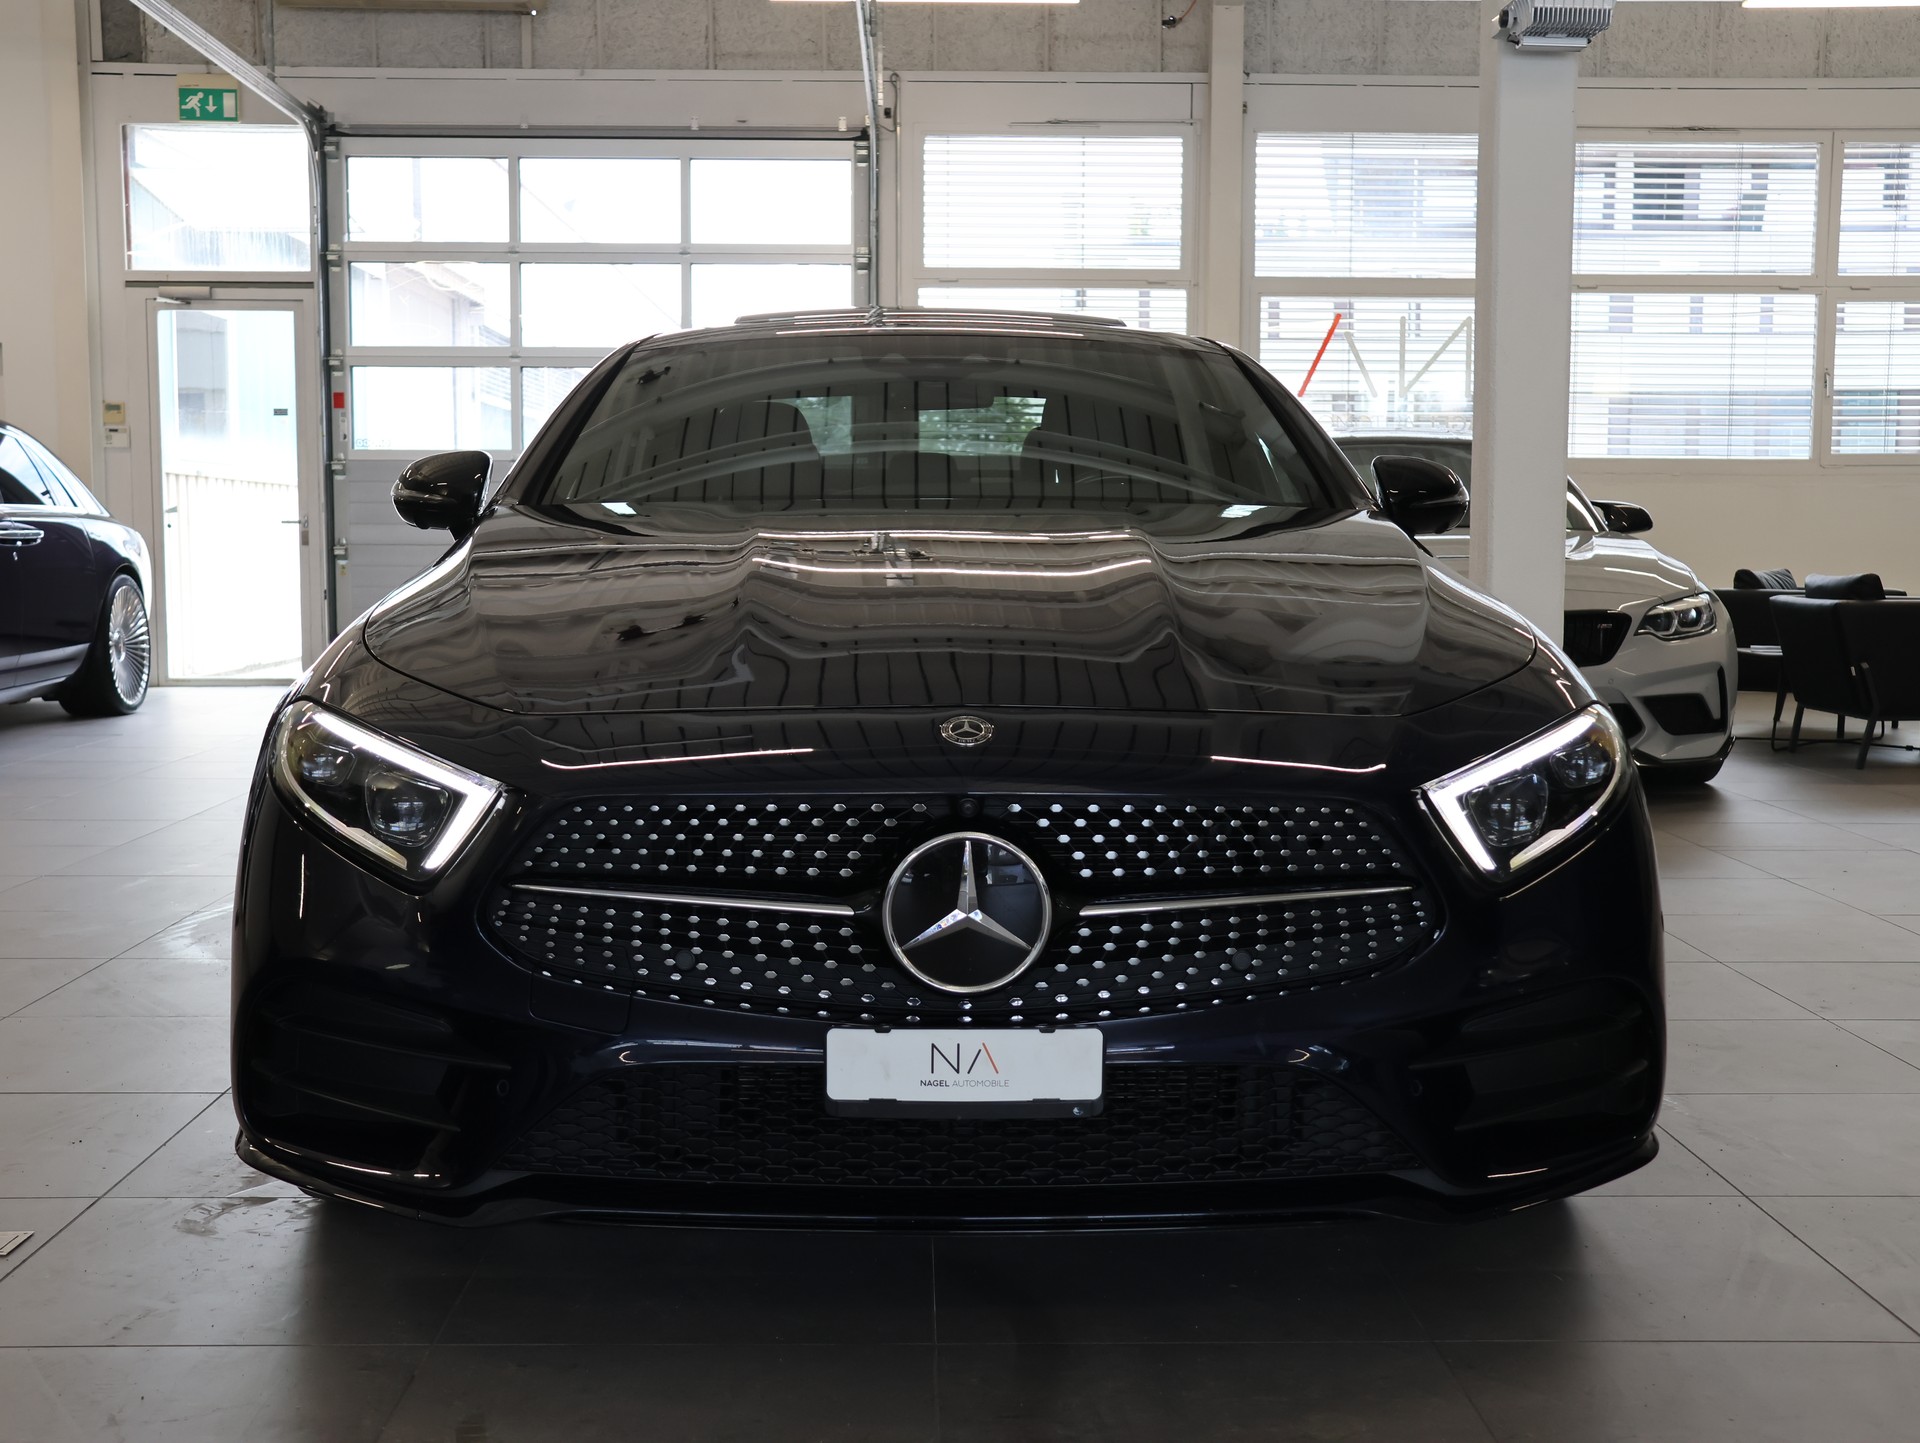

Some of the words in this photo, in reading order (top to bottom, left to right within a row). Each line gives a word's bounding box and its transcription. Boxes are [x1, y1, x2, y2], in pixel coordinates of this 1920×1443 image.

[930, 1042, 999, 1075] NA
[919, 1079, 950, 1088] NAGEL
[951, 1079, 1010, 1088] AUTOMOBILE
